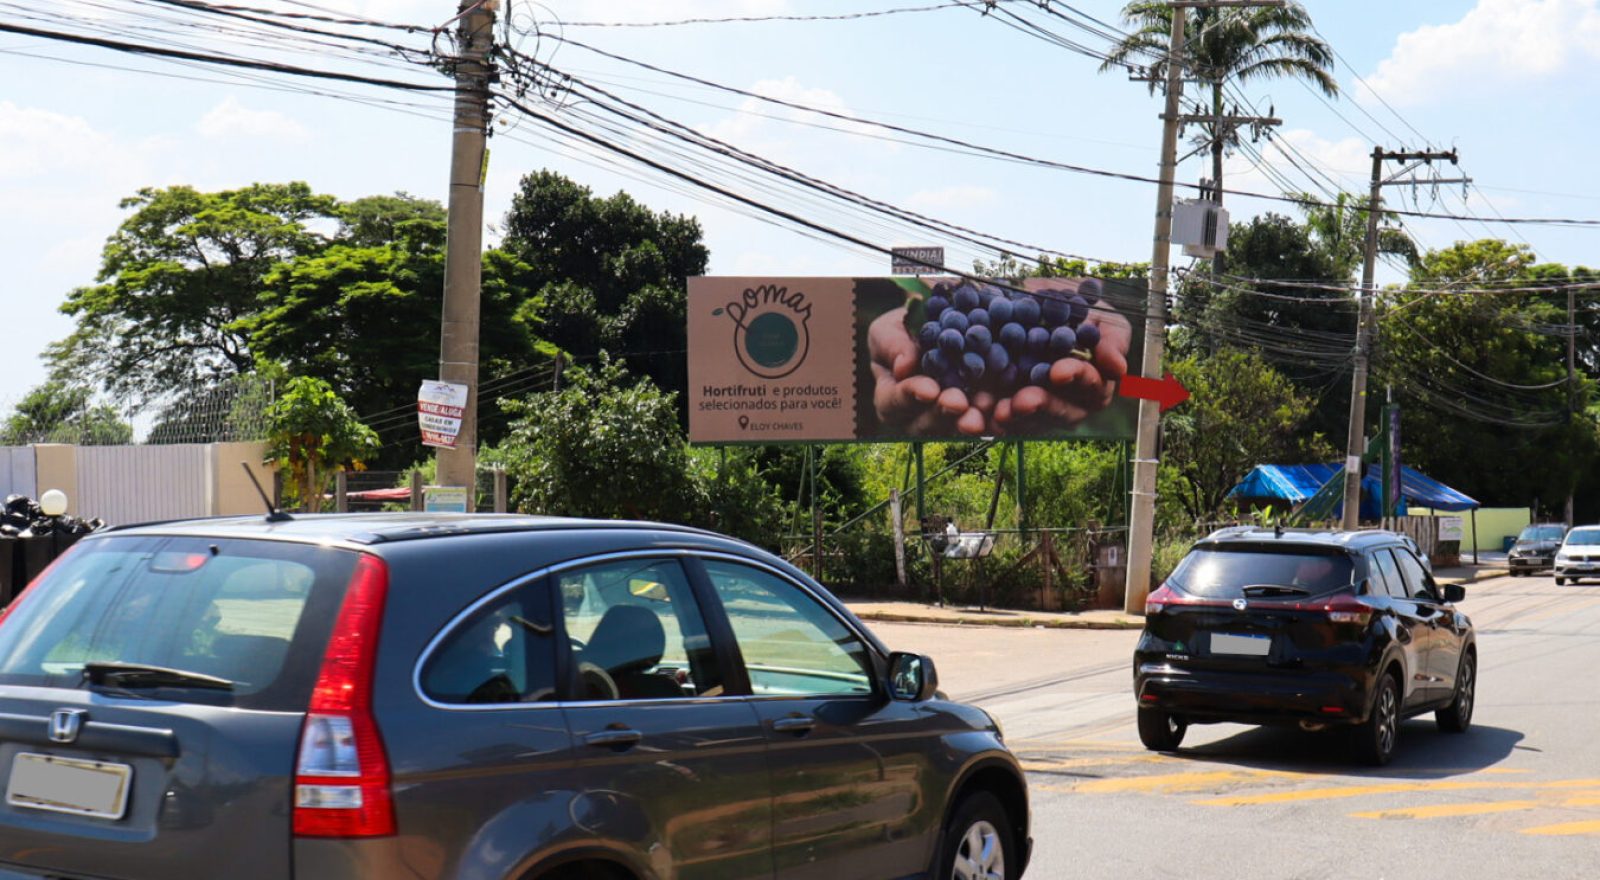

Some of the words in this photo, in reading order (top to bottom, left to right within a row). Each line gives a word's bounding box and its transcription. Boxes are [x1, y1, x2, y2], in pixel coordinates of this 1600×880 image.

[703, 385, 767, 397] Hortifruti
[773, 386, 781, 396] e
[783, 384, 839, 398] produtos
[699, 399, 777, 411] selecionados
[780, 400, 808, 412] para
[810, 398, 842, 410] você!
[750, 422, 770, 431] ELOY
[772, 421, 803, 431] CHAVES
